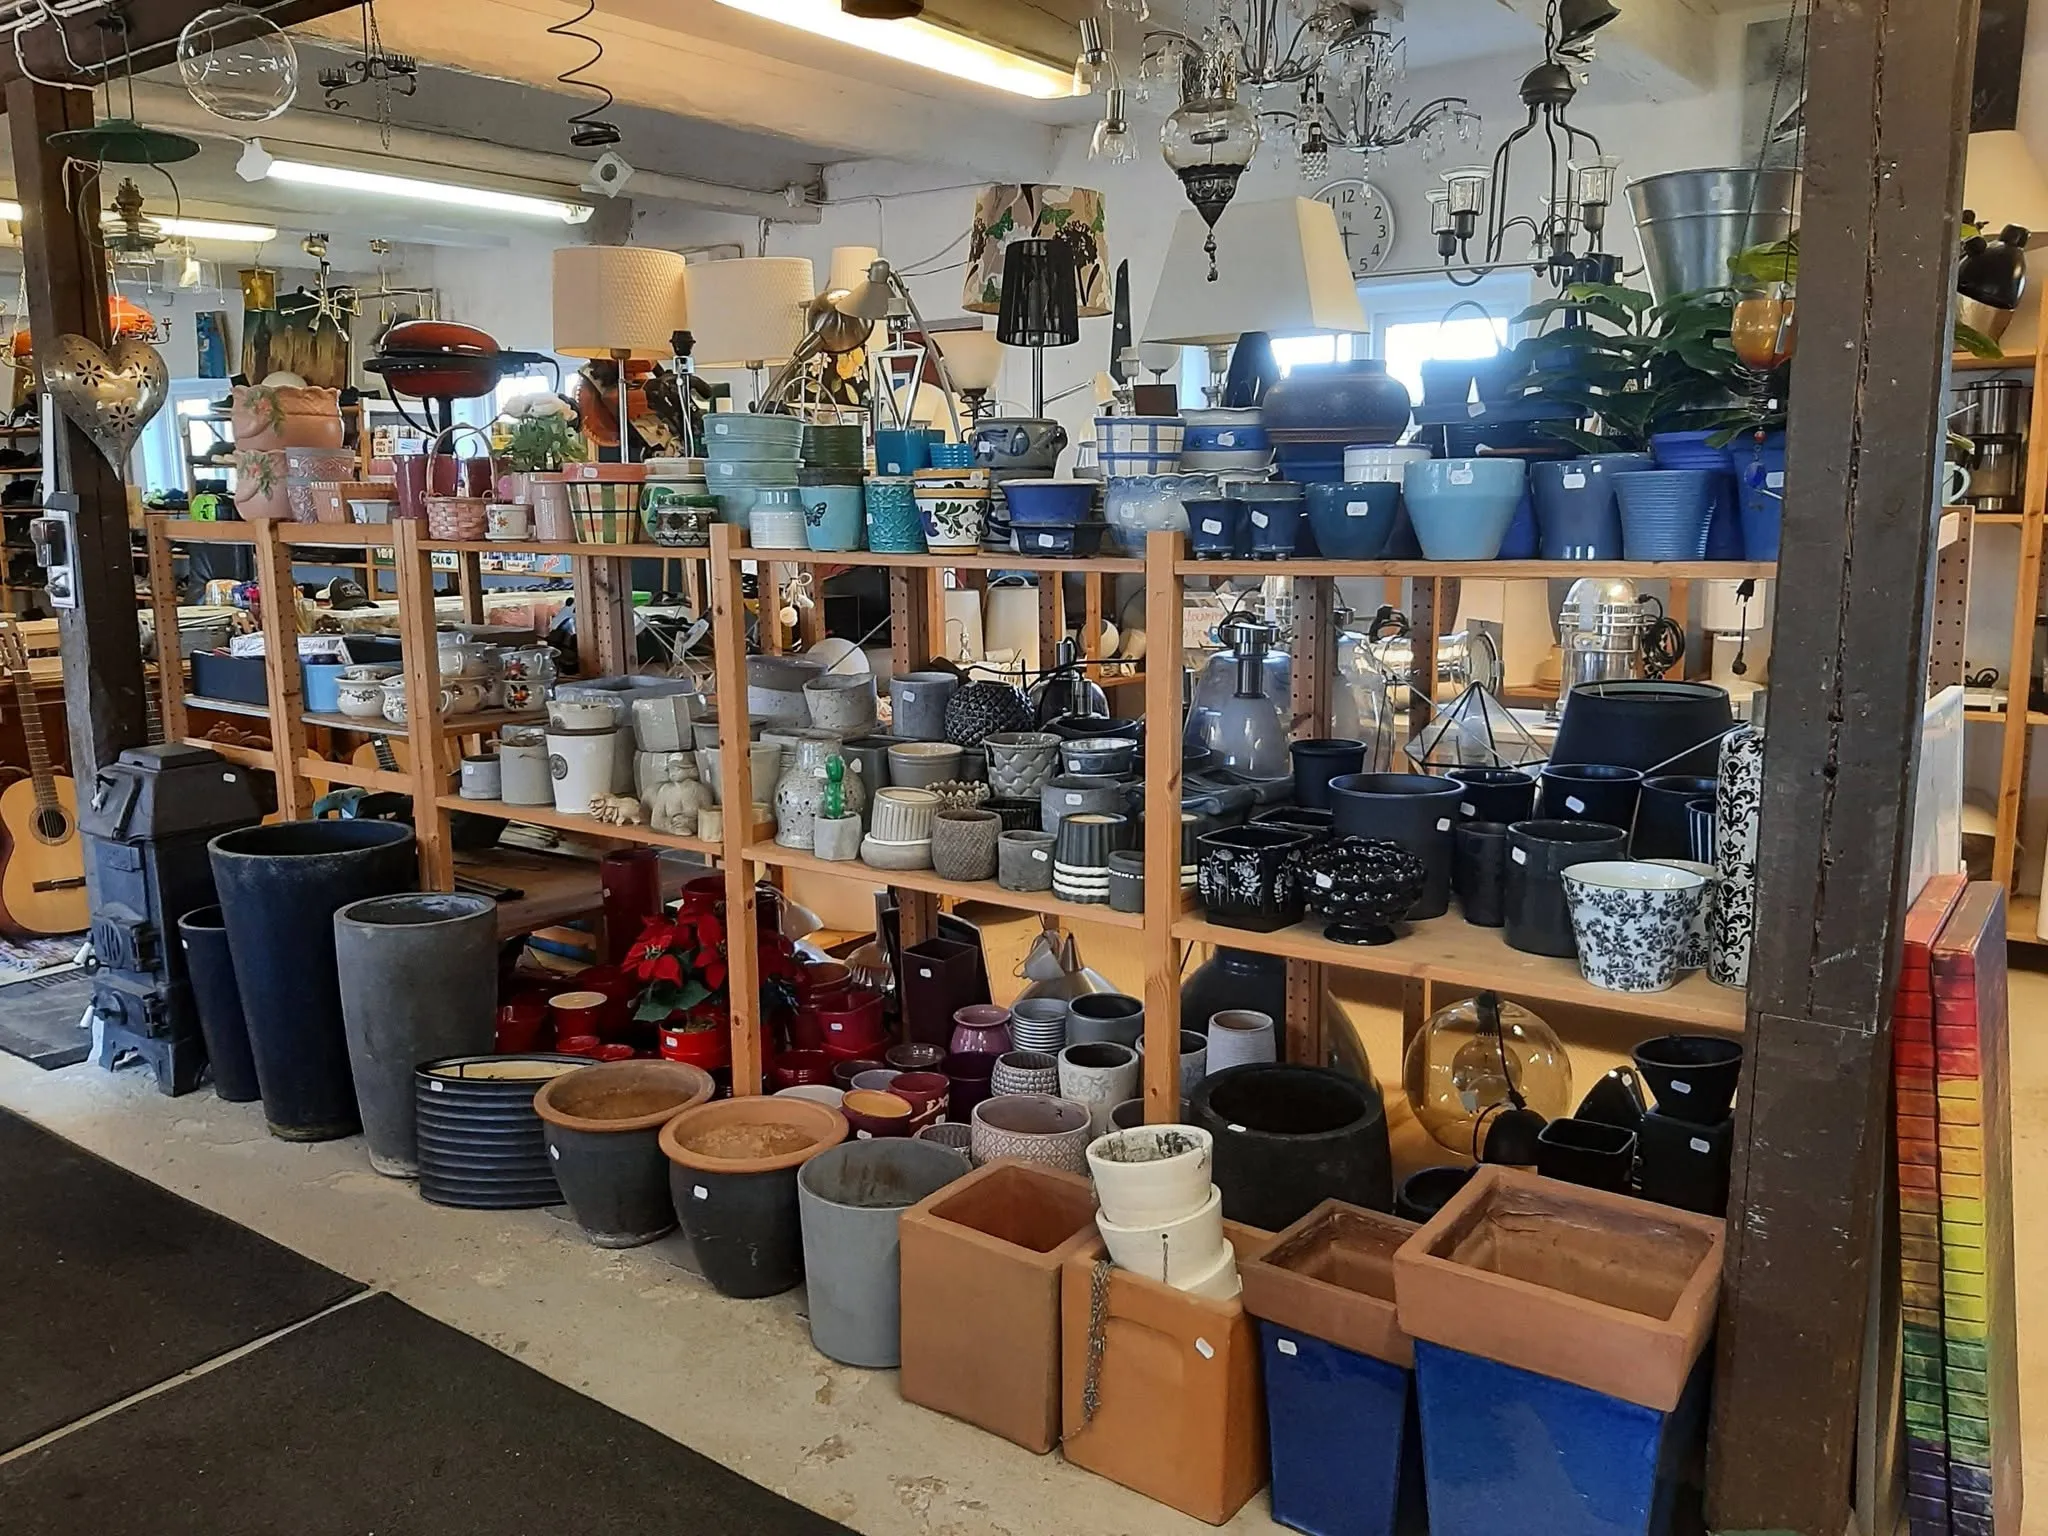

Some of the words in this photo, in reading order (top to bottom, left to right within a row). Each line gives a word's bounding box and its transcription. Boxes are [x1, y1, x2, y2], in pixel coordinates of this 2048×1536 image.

[1342, 189, 1355, 203] 12
[1374, 206, 1382, 219] 2
[1378, 225, 1386, 239] 3
[1371, 244, 1380, 256] 4
[1359, 258, 1368, 271] 5
